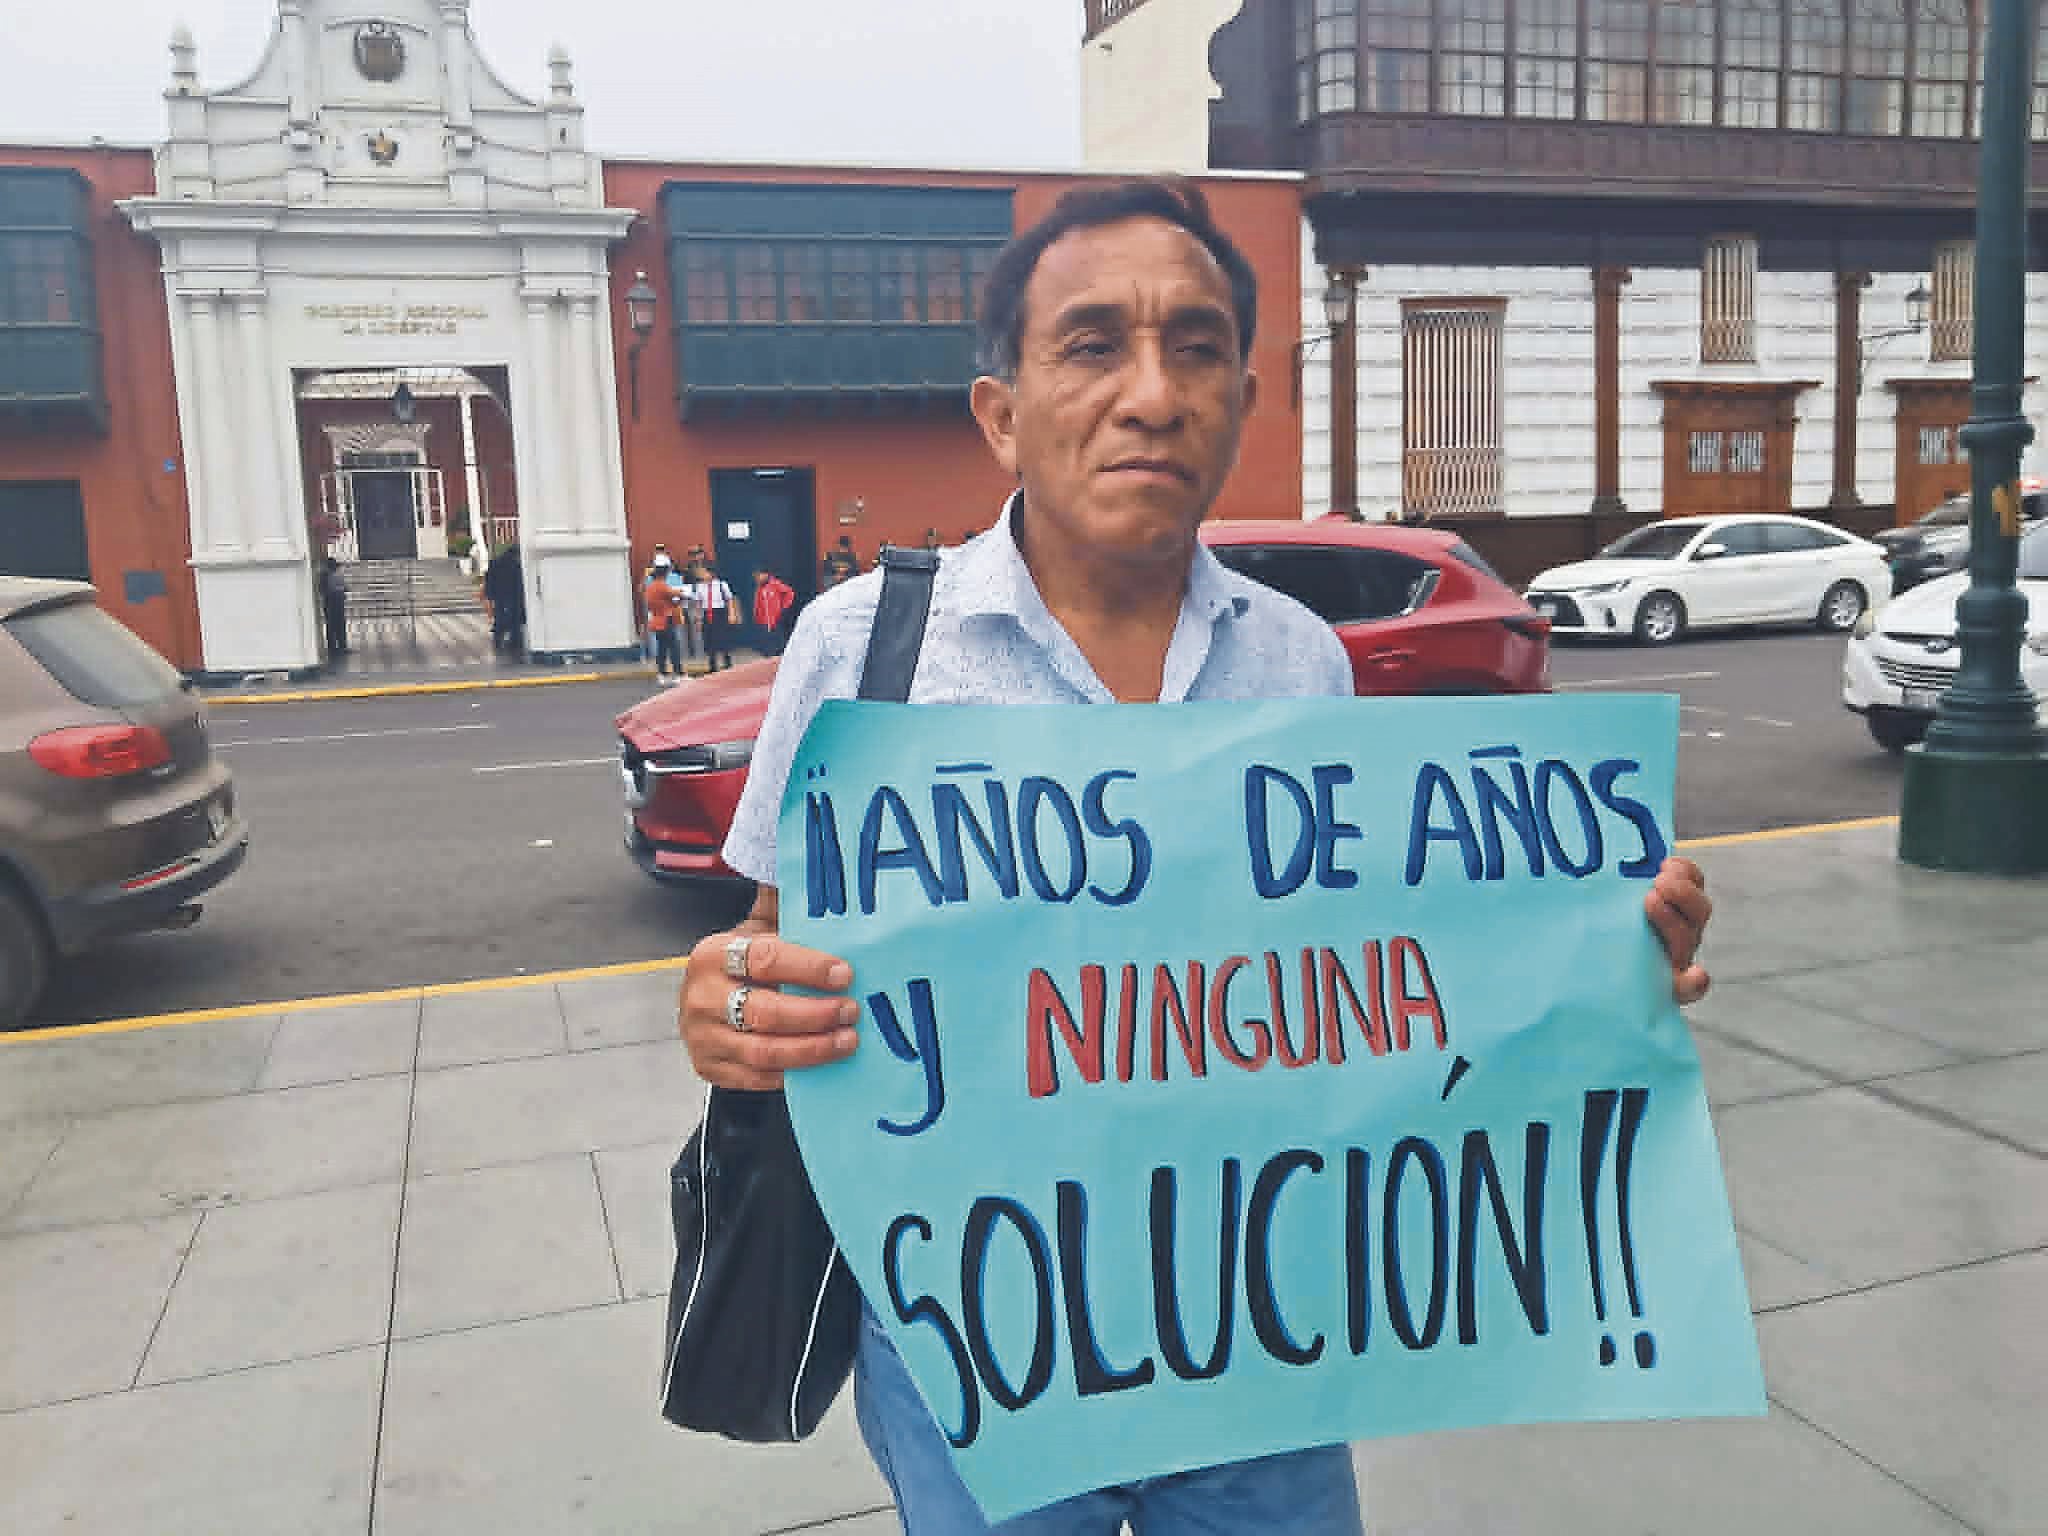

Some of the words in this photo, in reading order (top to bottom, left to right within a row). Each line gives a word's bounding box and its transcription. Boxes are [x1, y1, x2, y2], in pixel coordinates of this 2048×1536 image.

[1245, 762, 1363, 898] DE
[1405, 745, 1667, 886] AÑOS
[1028, 935, 1449, 1098] NINGUNA
[883, 1056, 1658, 1449] SOLUCIÓN!!
